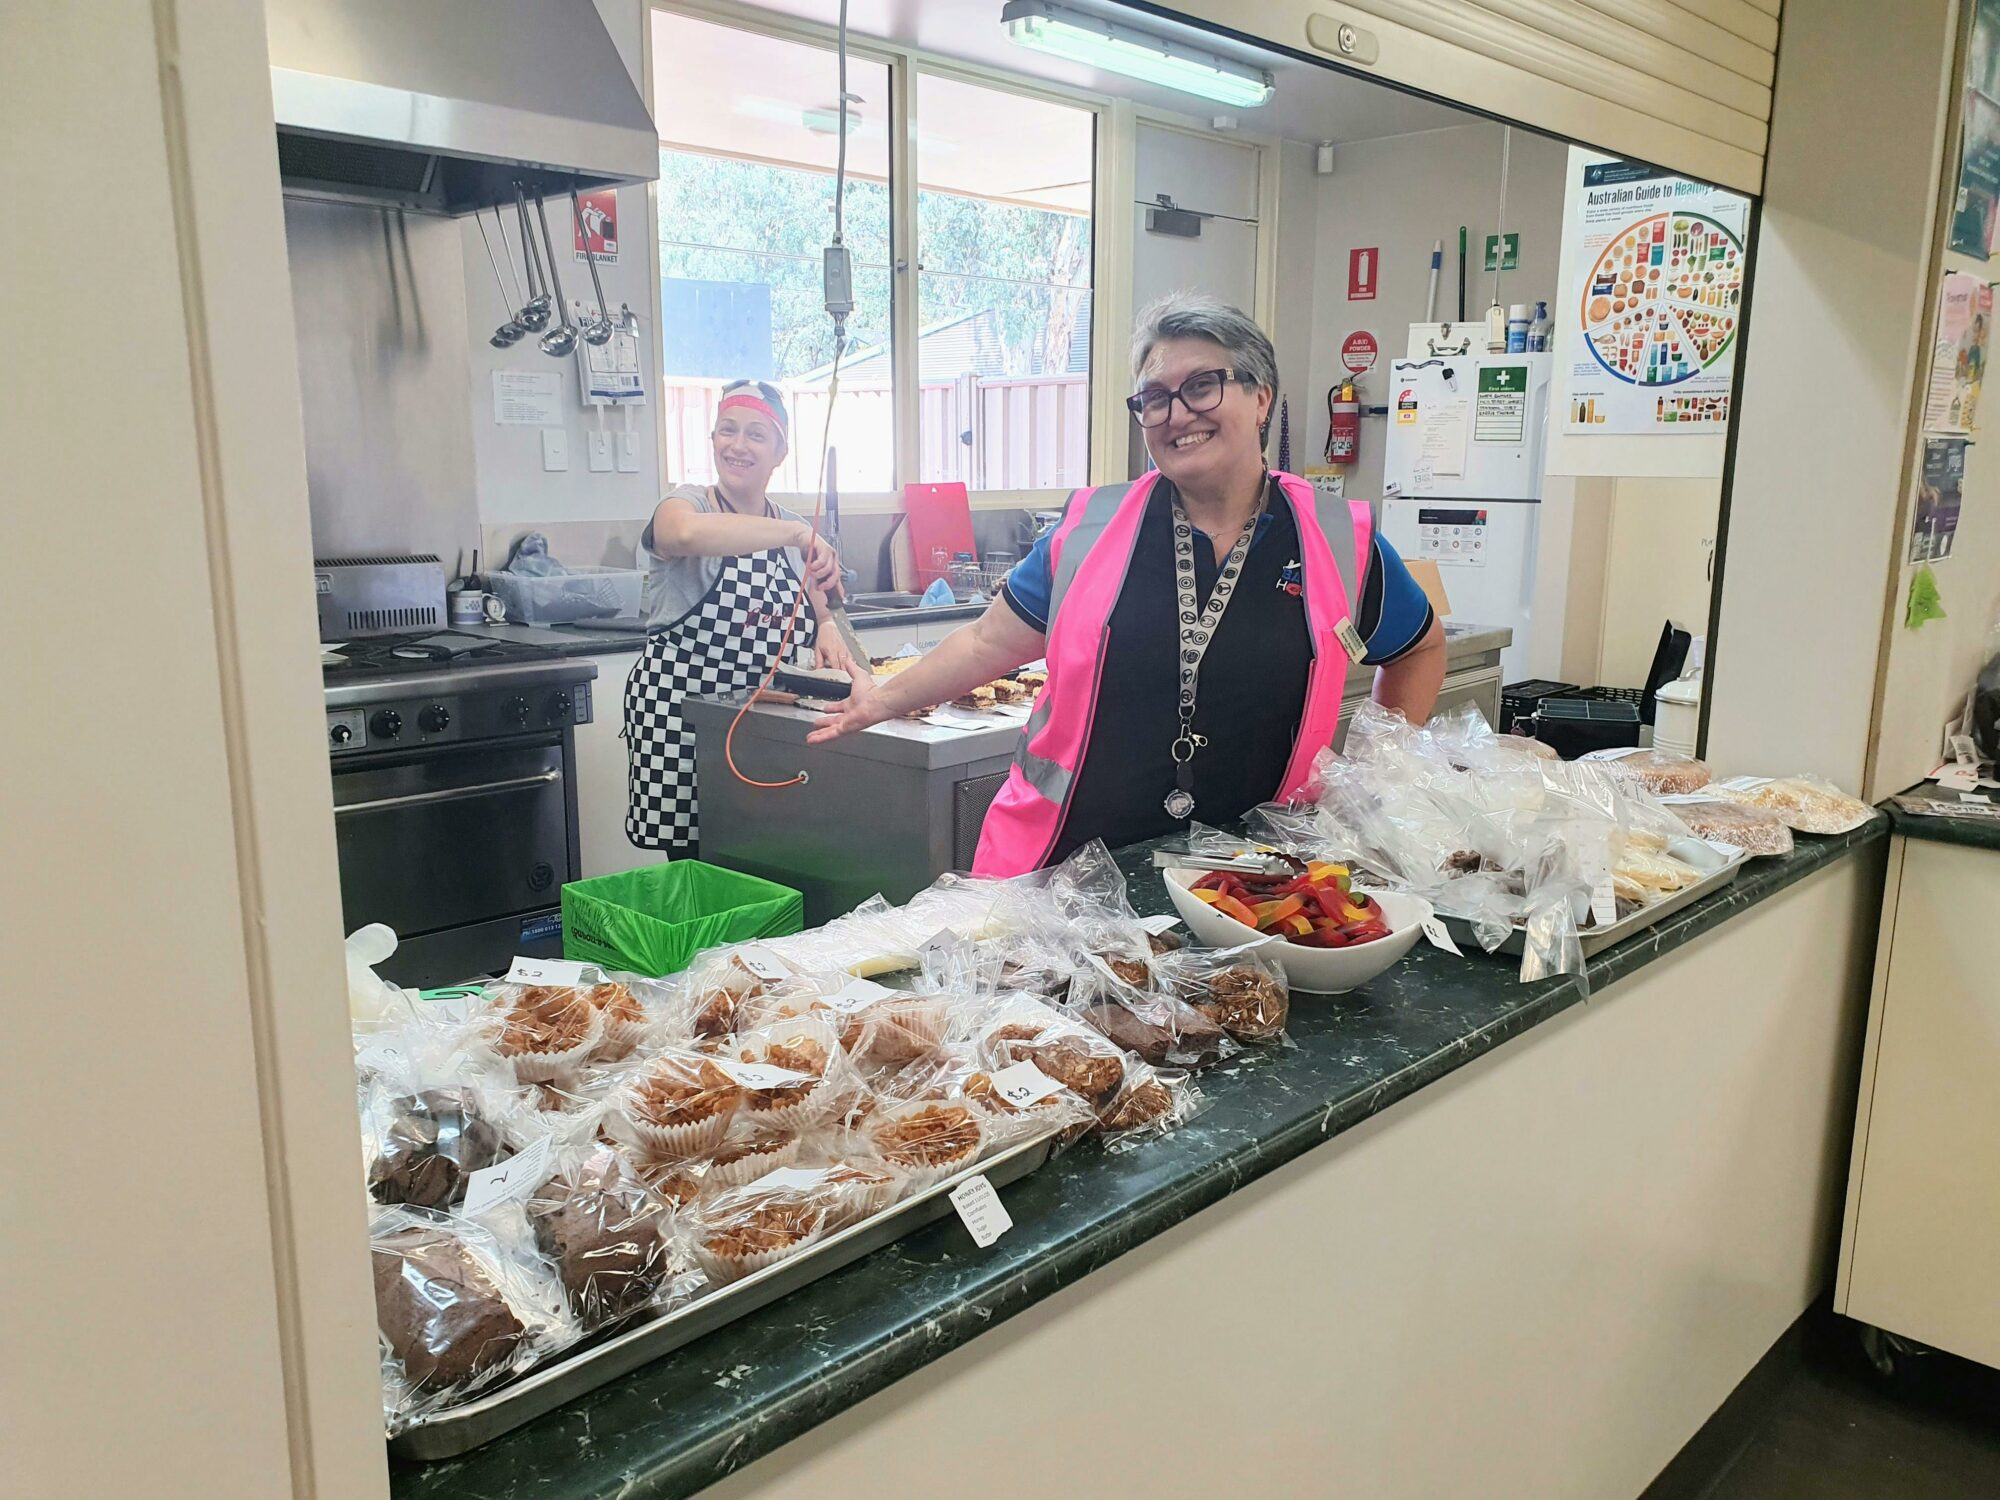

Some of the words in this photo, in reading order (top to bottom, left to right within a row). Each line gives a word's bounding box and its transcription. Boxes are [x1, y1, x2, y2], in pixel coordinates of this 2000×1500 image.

[1587, 190, 1633, 206] Australian
[1635, 184, 1662, 201] Guide
[1663, 184, 1673, 198] to
[576, 252, 590, 262] FIR
[590, 253, 617, 263] BLANKET
[1007, 1086, 1031, 1100] $2
[957, 1188, 976, 1202] HONEY
[975, 1182, 987, 1193] JOYS
